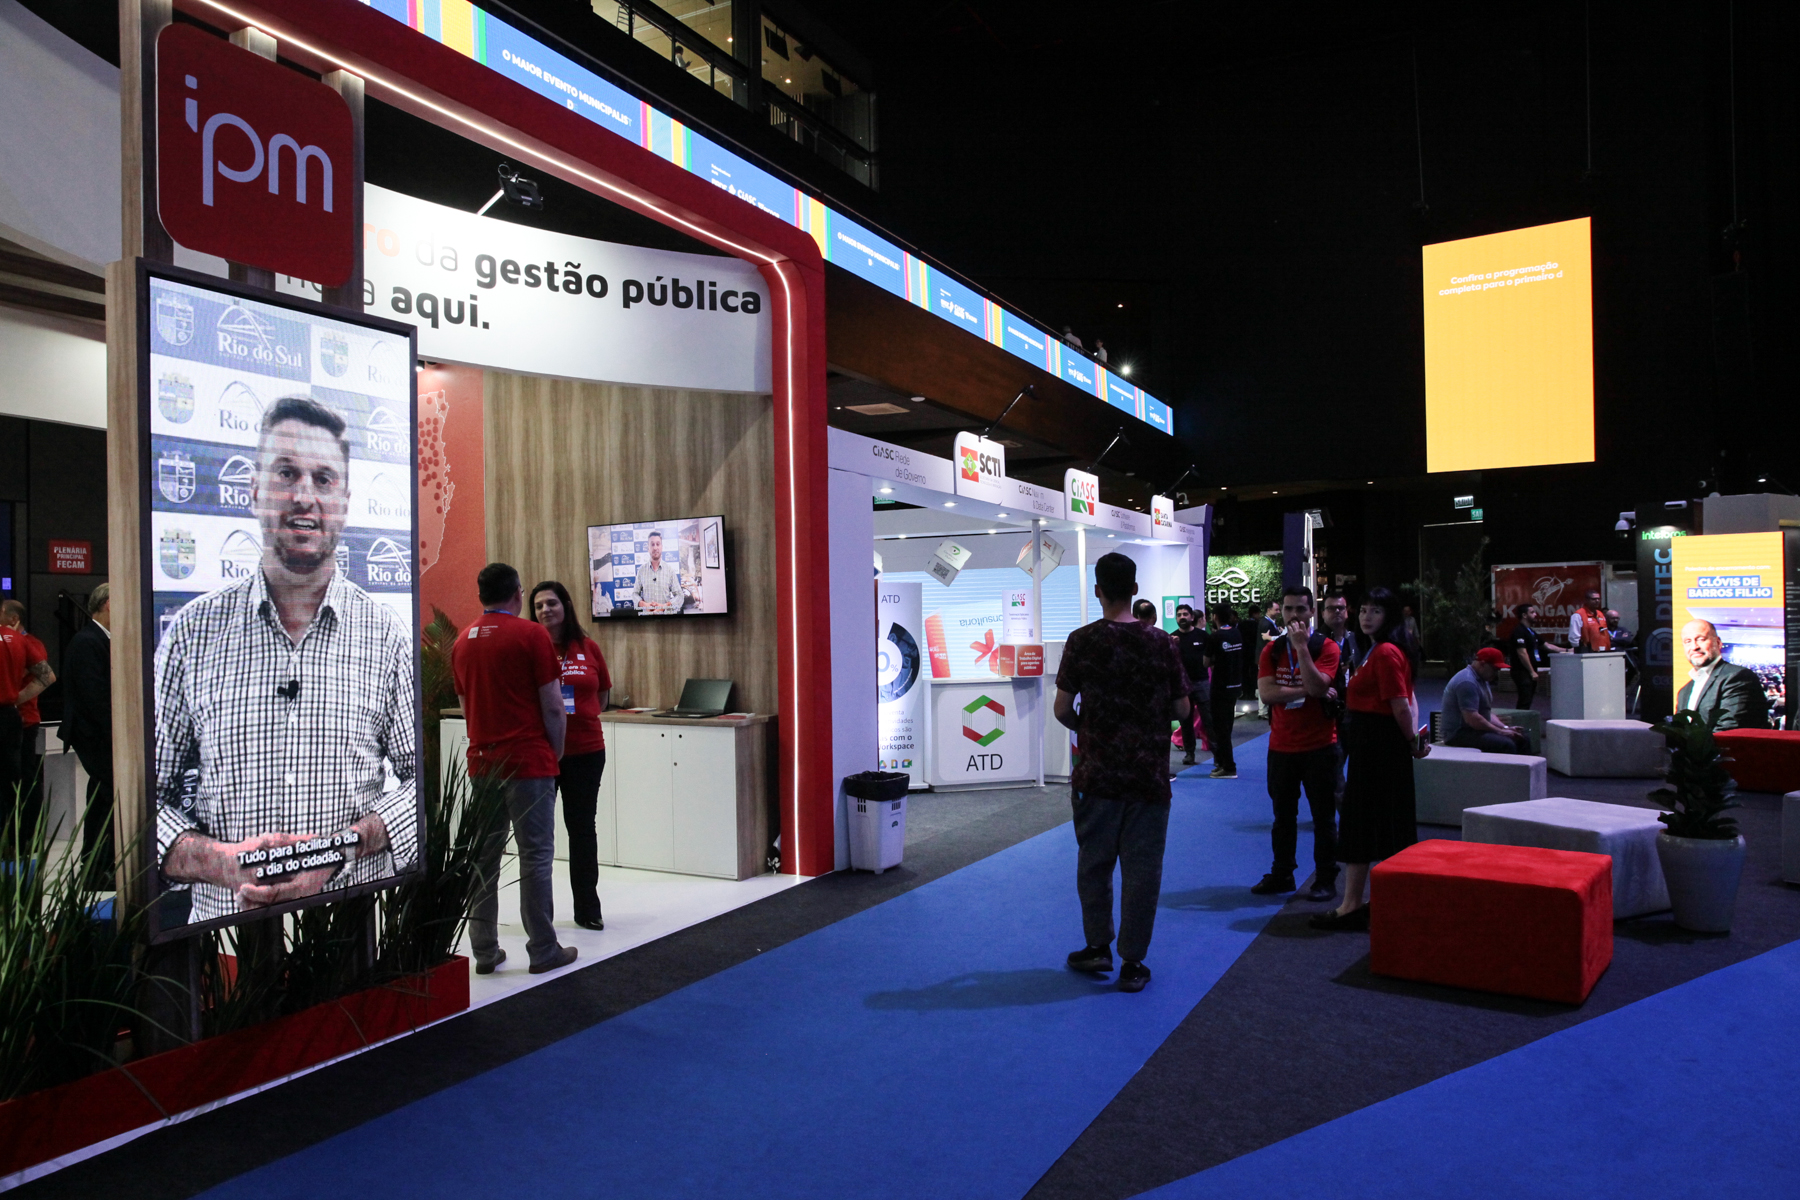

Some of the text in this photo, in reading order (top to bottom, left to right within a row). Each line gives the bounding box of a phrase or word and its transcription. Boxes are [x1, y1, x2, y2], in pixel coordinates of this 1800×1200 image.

[502, 49, 511, 60] O
[512, 54, 542, 79] MAIOR
[544, 70, 578, 97] EVENTO
[185, 73, 333, 213] ipm
[415, 231, 459, 272] da
[474, 253, 609, 300] gestão
[622, 276, 762, 315] pública
[1450, 274, 1484, 284] Confira
[1494, 262, 1558, 280] programação
[1438, 284, 1482, 296] completa
[1483, 280, 1505, 291] para
[1514, 272, 1555, 286] primeiro
[391, 285, 490, 330] aqui.
[216, 331, 248, 356] Rio
[253, 344, 273, 362] do
[275, 345, 302, 368] Sul
[218, 408, 248, 432] Rio
[367, 431, 390, 452] Rio
[895, 450, 910, 466] Rede
[979, 452, 1001, 478] SCTI
[895, 468, 926, 484] de Governo
[218, 484, 249, 508] Rio
[54, 545, 88, 554] PLENÁRIA
[56, 560, 85, 568] FECAM
[220, 559, 250, 580] Rio
[368, 564, 412, 582] Rio do
[1698, 576, 1759, 587] CLÓVIS DE
[881, 594, 900, 604] ATD
[1688, 588, 1772, 598] BARROS FILHO
[959, 614, 1004, 628] onsultoria
[966, 753, 1004, 772] ATD
[238, 832, 358, 866] Tudo para facilitar o dia
[256, 851, 344, 878] a dia do cidadão.
